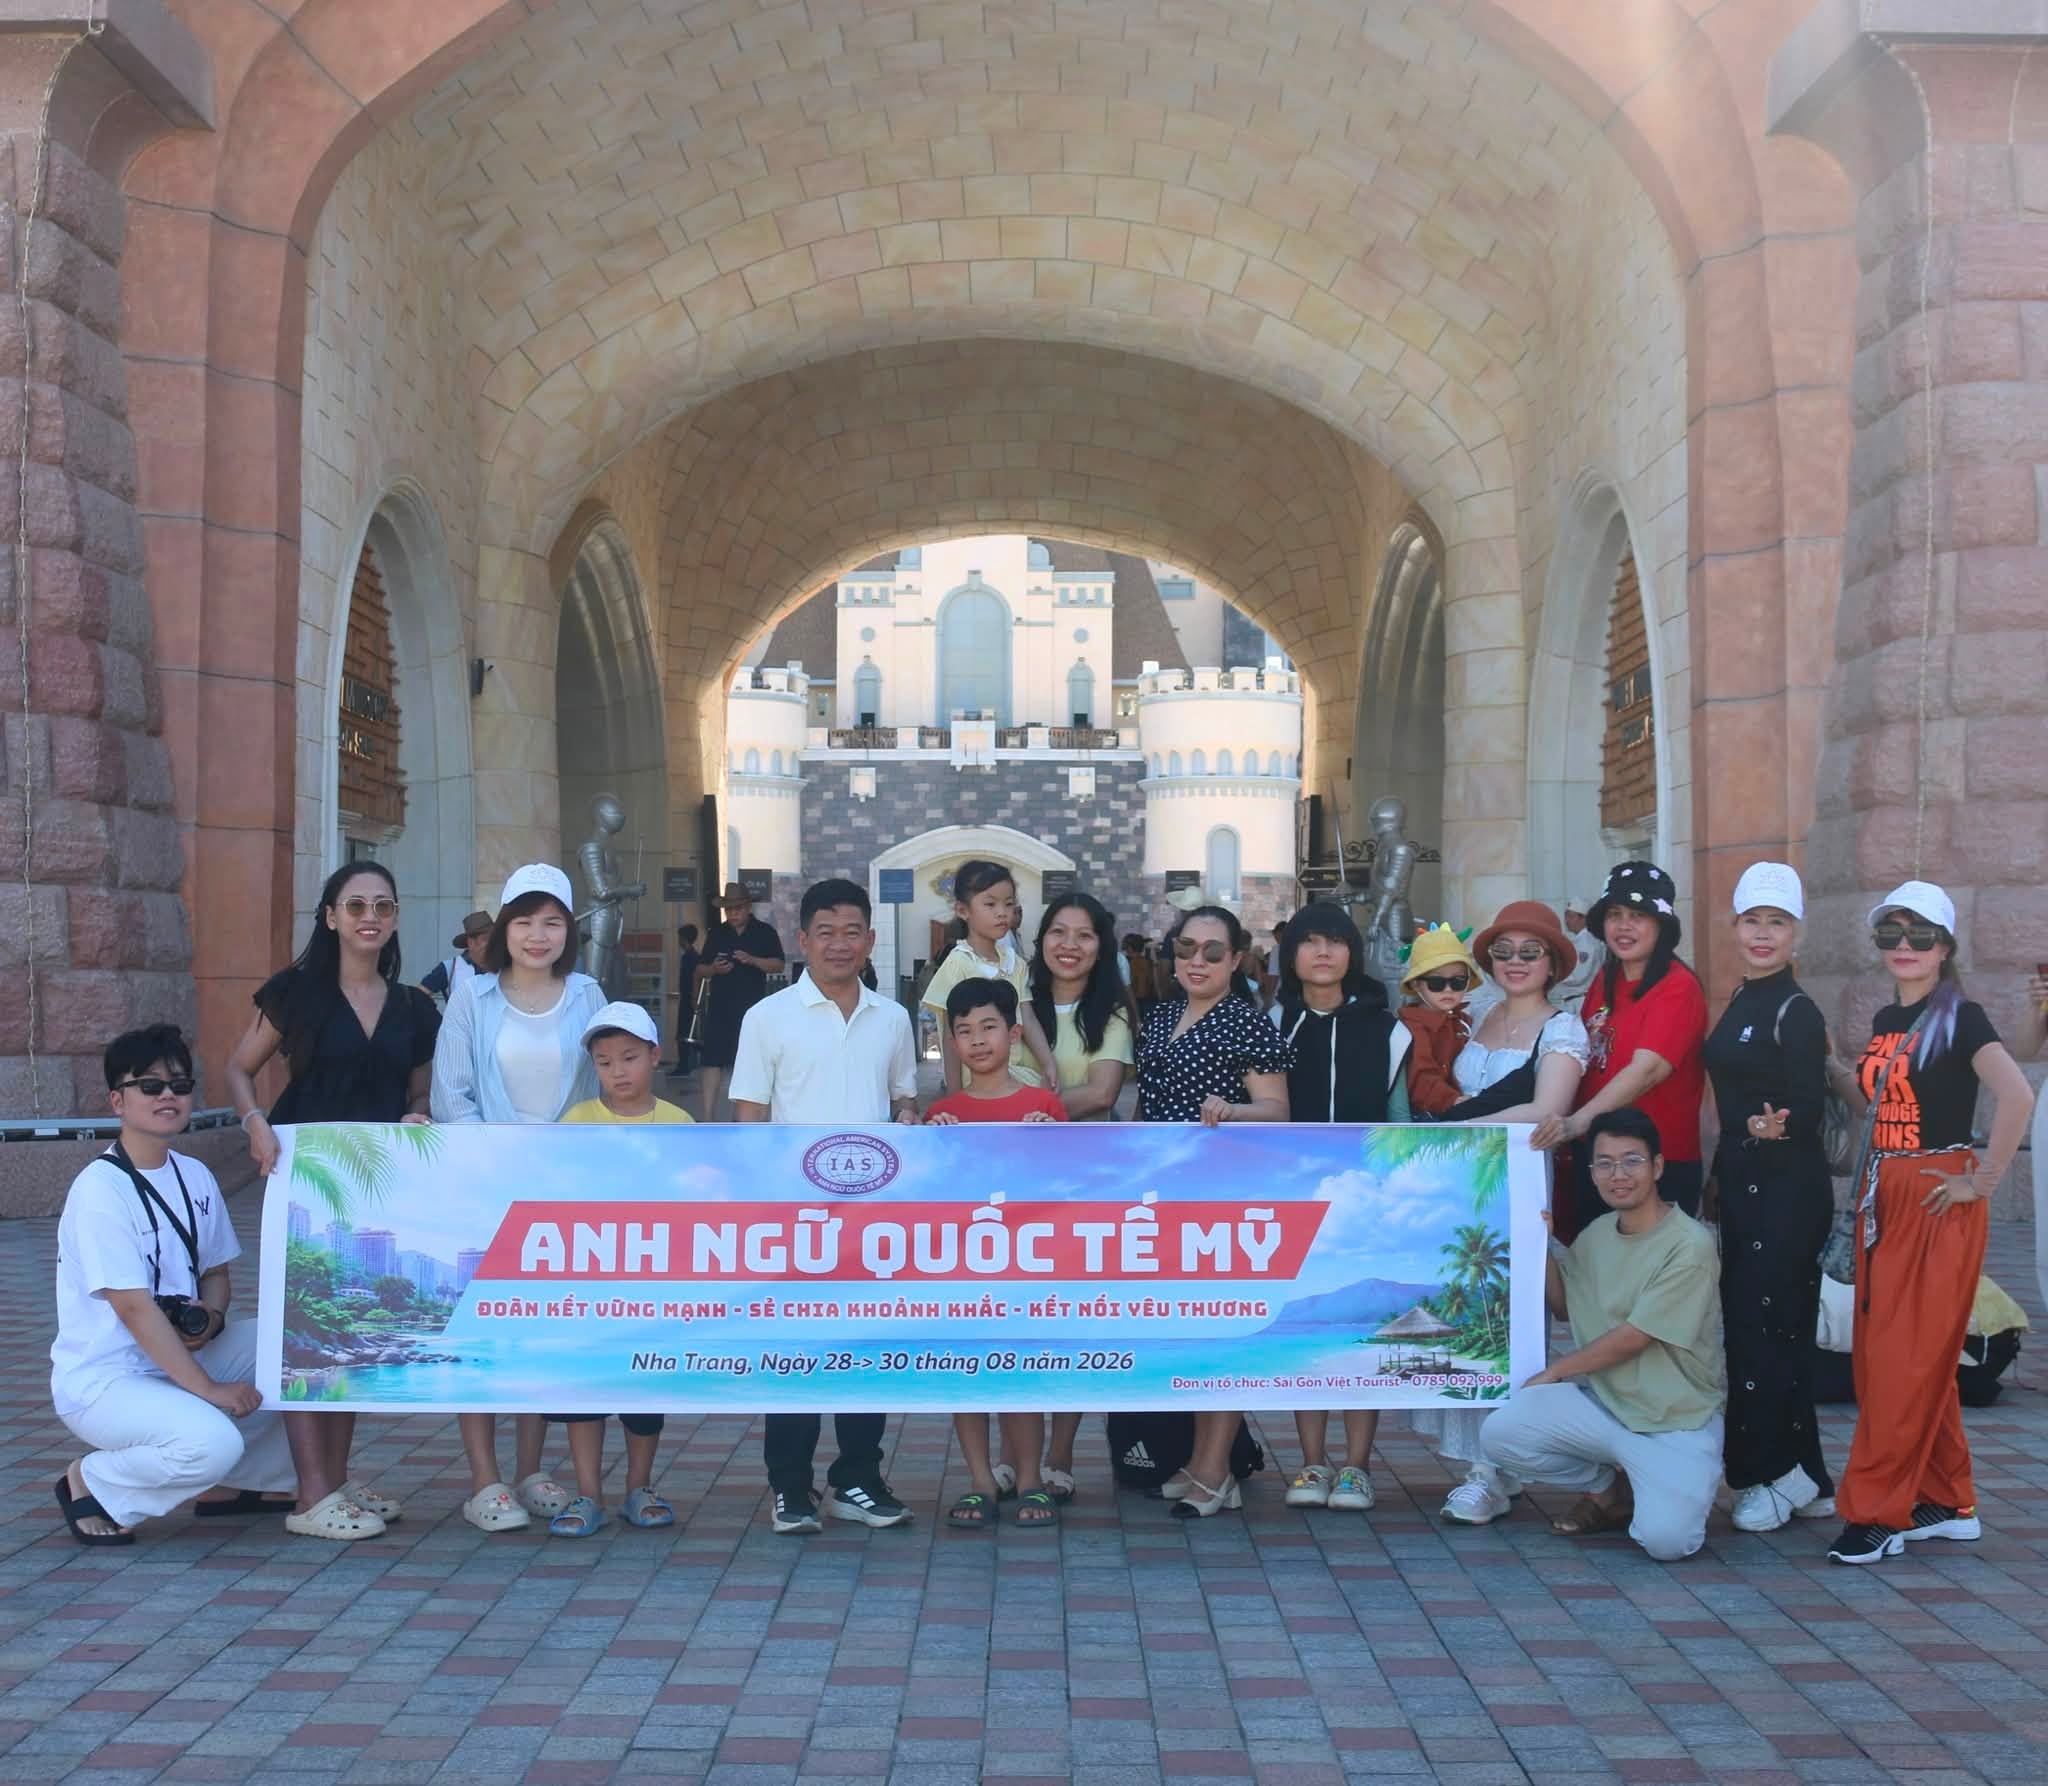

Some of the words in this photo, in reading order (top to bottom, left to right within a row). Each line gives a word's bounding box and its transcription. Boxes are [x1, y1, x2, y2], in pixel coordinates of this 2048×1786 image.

[520, 1222, 671, 1273] ANH
[692, 1208, 843, 1275] NGỮ
[862, 1191, 1055, 1279] QUỐC
[1072, 1191, 1160, 1273] TẾ
[1181, 1207, 1282, 1273] MỸ
[477, 1298, 540, 1317] ĐOÀN
[547, 1294, 589, 1317] KẾT
[596, 1299, 656, 1318] VỮNG
[663, 1302, 727, 1322] MẠNH
[749, 1297, 776, 1318] SẺ
[783, 1302, 840, 1318] CHIA
[847, 1297, 941, 1318] KHOẢNH
[949, 1294, 1007, 1318] KHẮC
[1029, 1294, 1071, 1318] KẾT
[1078, 1294, 1121, 1317] NỐI
[1128, 1298, 1170, 1317] YÊU
[1177, 1301, 1268, 1317] THƯƠNG
[631, 1352, 677, 1370] Nha
[685, 1352, 752, 1375] Trang,
[760, 1351, 819, 1375] Ngày
[823, 1352, 873, 1370] 28->
[879, 1352, 909, 1370] 30
[916, 1352, 980, 1375] tháng
[986, 1352, 1017, 1370] 08
[1023, 1353, 1071, 1370] năm
[1077, 1352, 1134, 1370] 2026
[1203, 1377, 1214, 1391] vị
[1326, 1376, 1351, 1390] Việt
[1355, 1375, 1400, 1387] Tourist
[1412, 1375, 1447, 1387] 0785
[1449, 1375, 1475, 1387] 092
[1478, 1375, 1503, 1387] 999
[1123, 1456, 1156, 1468] adidas
